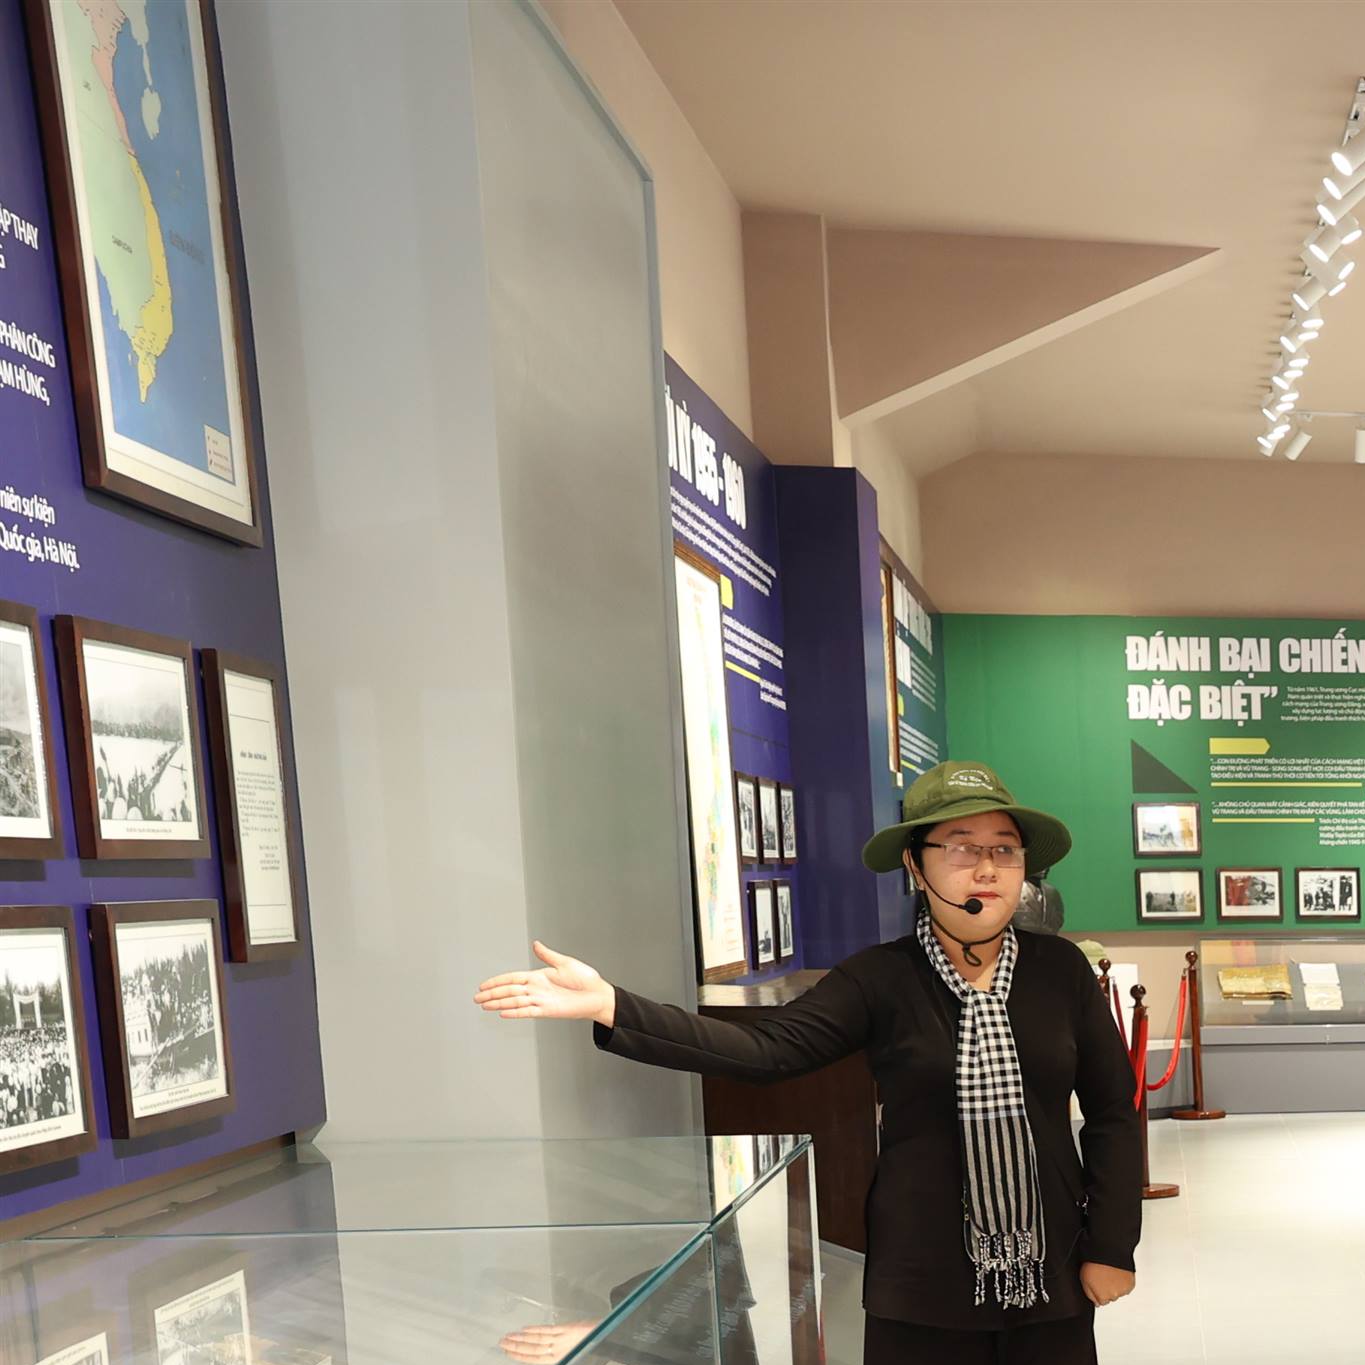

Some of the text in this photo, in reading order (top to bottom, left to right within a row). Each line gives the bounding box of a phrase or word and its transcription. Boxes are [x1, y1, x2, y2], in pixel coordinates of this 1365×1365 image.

[11, 215, 38, 250] THAY
[27, 331, 55, 368] CÔNG
[15, 363, 50, 406] HÙNG,
[1125, 631, 1212, 672] ĐÁNH
[1218, 637, 1272, 679] BẠI
[1126, 678, 1193, 727] ĐẶC
